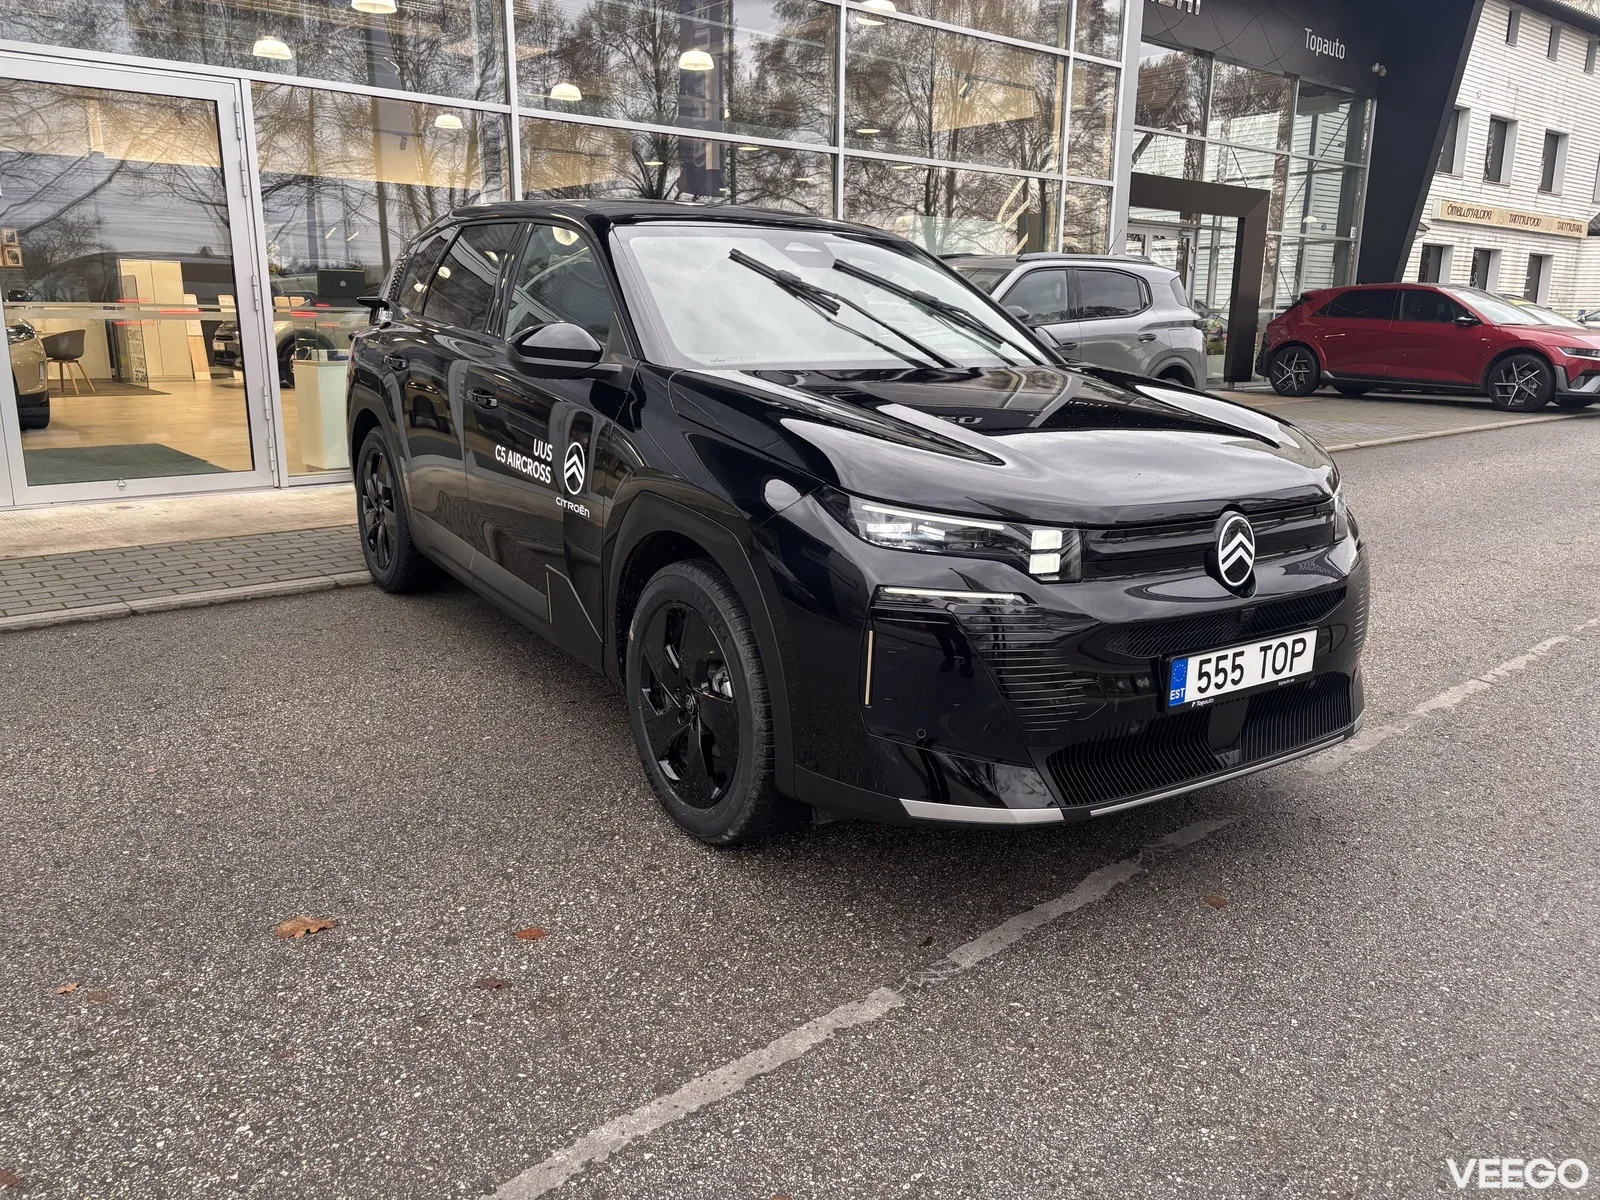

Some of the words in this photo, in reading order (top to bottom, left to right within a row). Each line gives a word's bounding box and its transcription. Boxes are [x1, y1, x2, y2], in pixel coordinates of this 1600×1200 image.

[1304, 27, 1346, 60] Topauto
[495, 444, 506, 463] C5
[507, 451, 551, 484] AIRCROSS
[533, 438, 553, 462] UUS
[1197, 650, 1245, 694] 555
[1260, 637, 1307, 679] TOP
[1170, 687, 1186, 700] EST
[1196, 698, 1215, 708] Topauto
